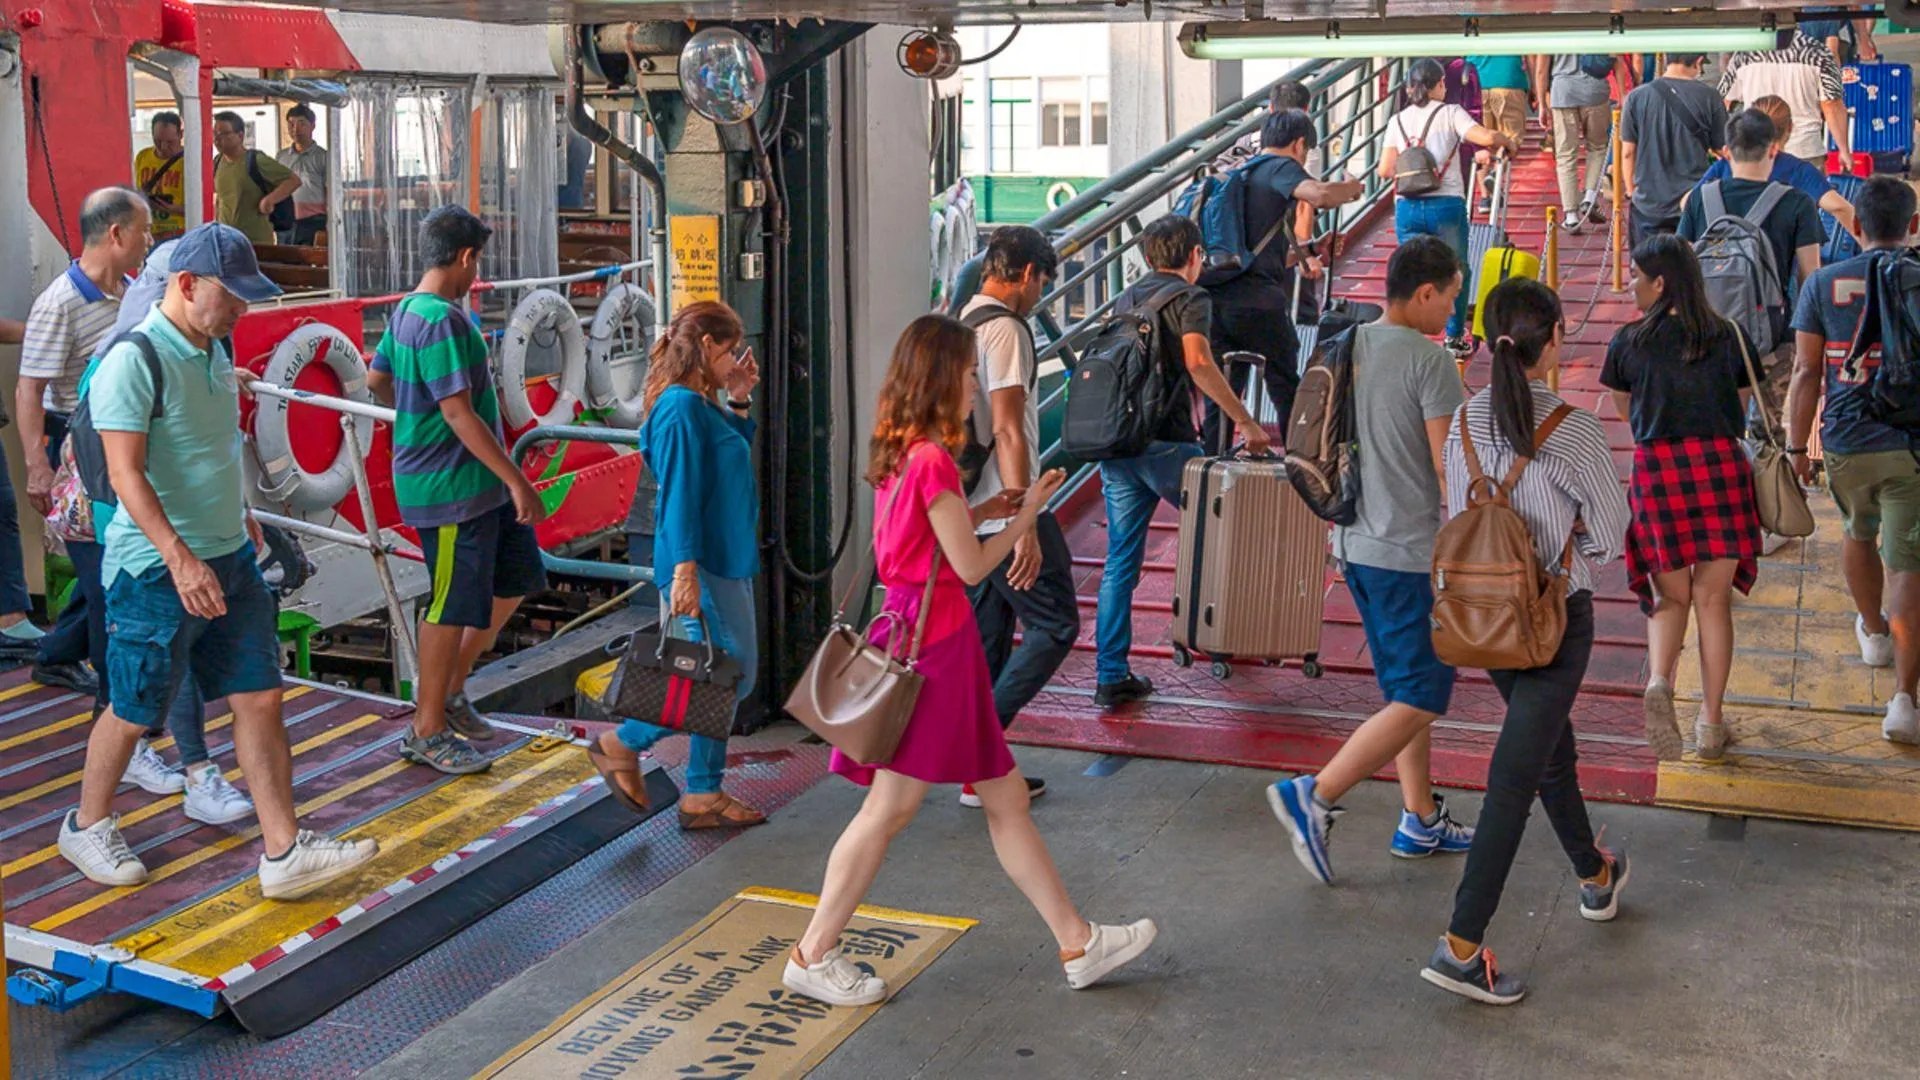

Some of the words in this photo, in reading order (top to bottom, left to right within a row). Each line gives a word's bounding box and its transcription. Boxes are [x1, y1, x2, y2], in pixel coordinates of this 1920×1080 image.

[683, 233, 708, 245] 小心
[284, 352, 304, 382] STAR
[556, 987, 674, 1055] BEWARE
[658, 962, 700, 985] OF
[694, 950, 727, 961] A
[659, 935, 797, 1022] GANGPLANK
[674, 927, 921, 1080] 心吊板動
